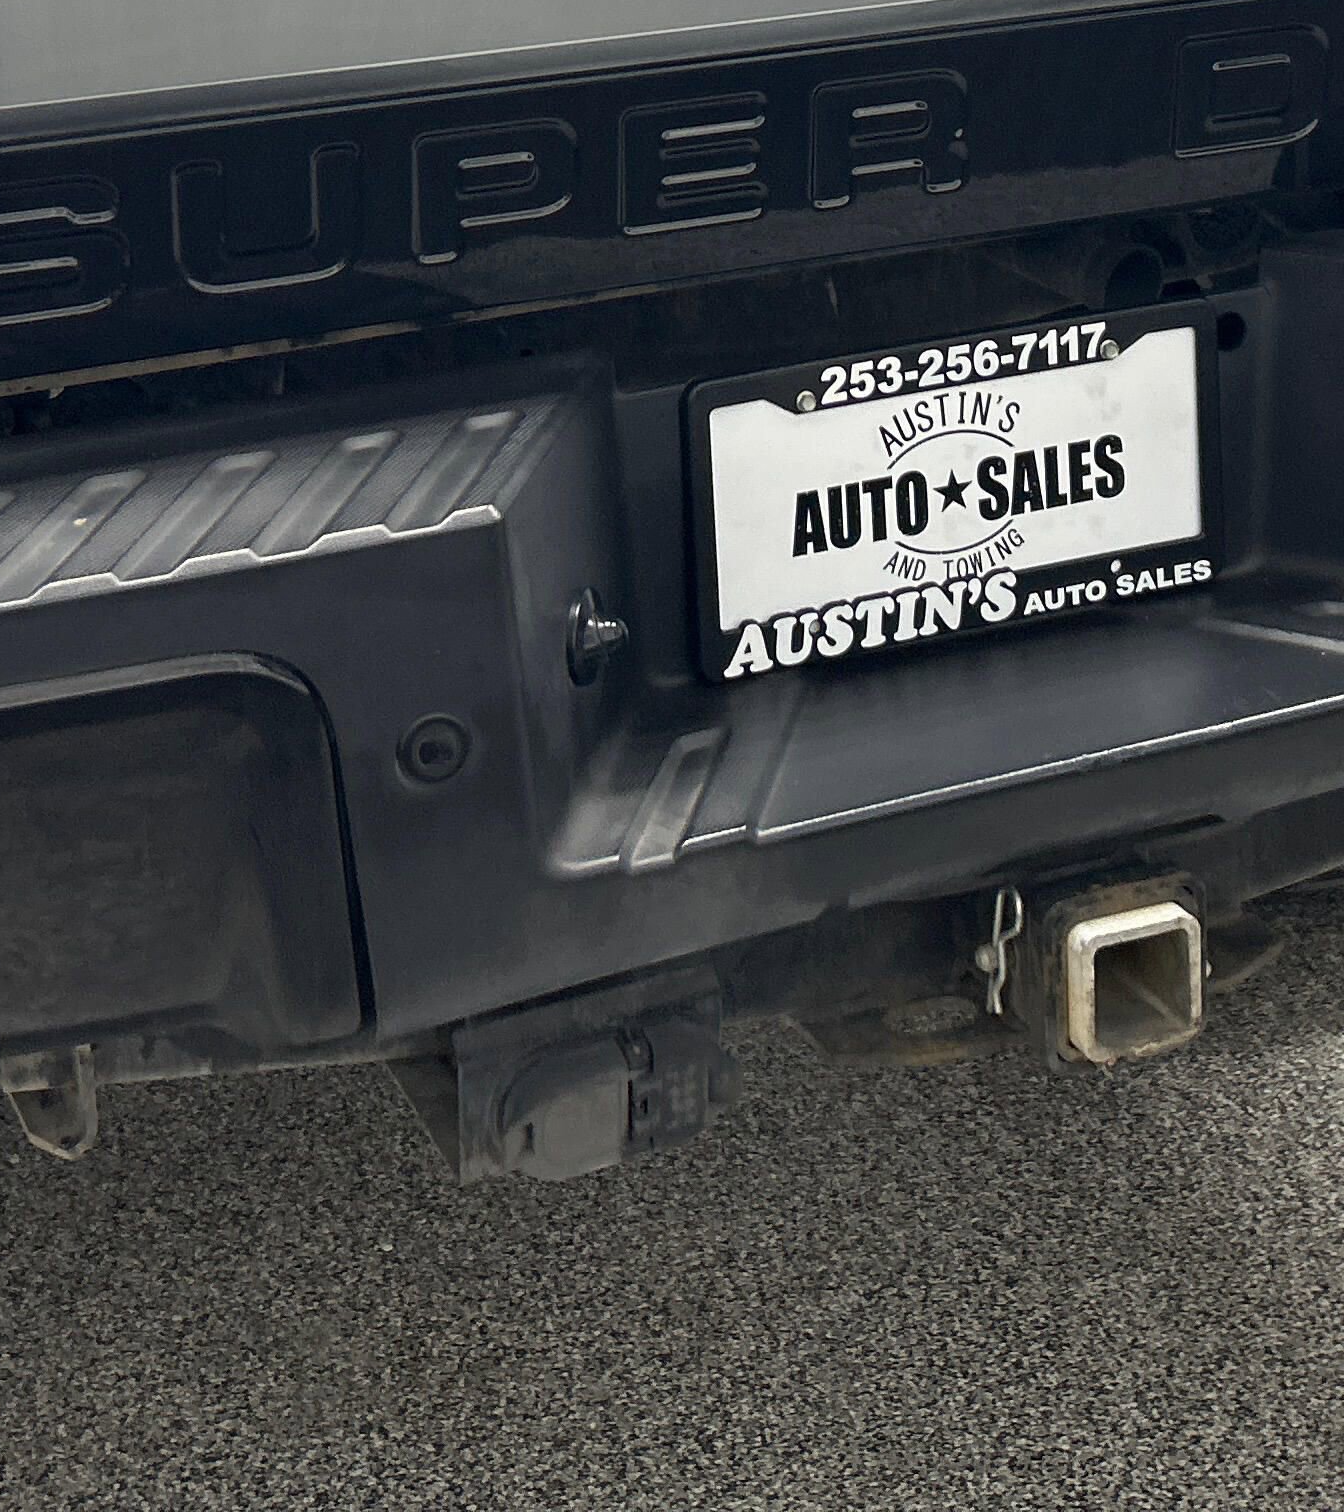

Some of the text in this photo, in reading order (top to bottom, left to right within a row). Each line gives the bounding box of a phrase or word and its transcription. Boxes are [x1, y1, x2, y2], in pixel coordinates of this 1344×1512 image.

[820, 321, 1107, 407] 253-256-7117
[878, 390, 1021, 457] AUSTIN'S
[792, 434, 1126, 557] AUTO SALES
[884, 527, 1026, 581] AND TOWING
[724, 559, 1212, 679] AUSTIN'S AUTO SALES
